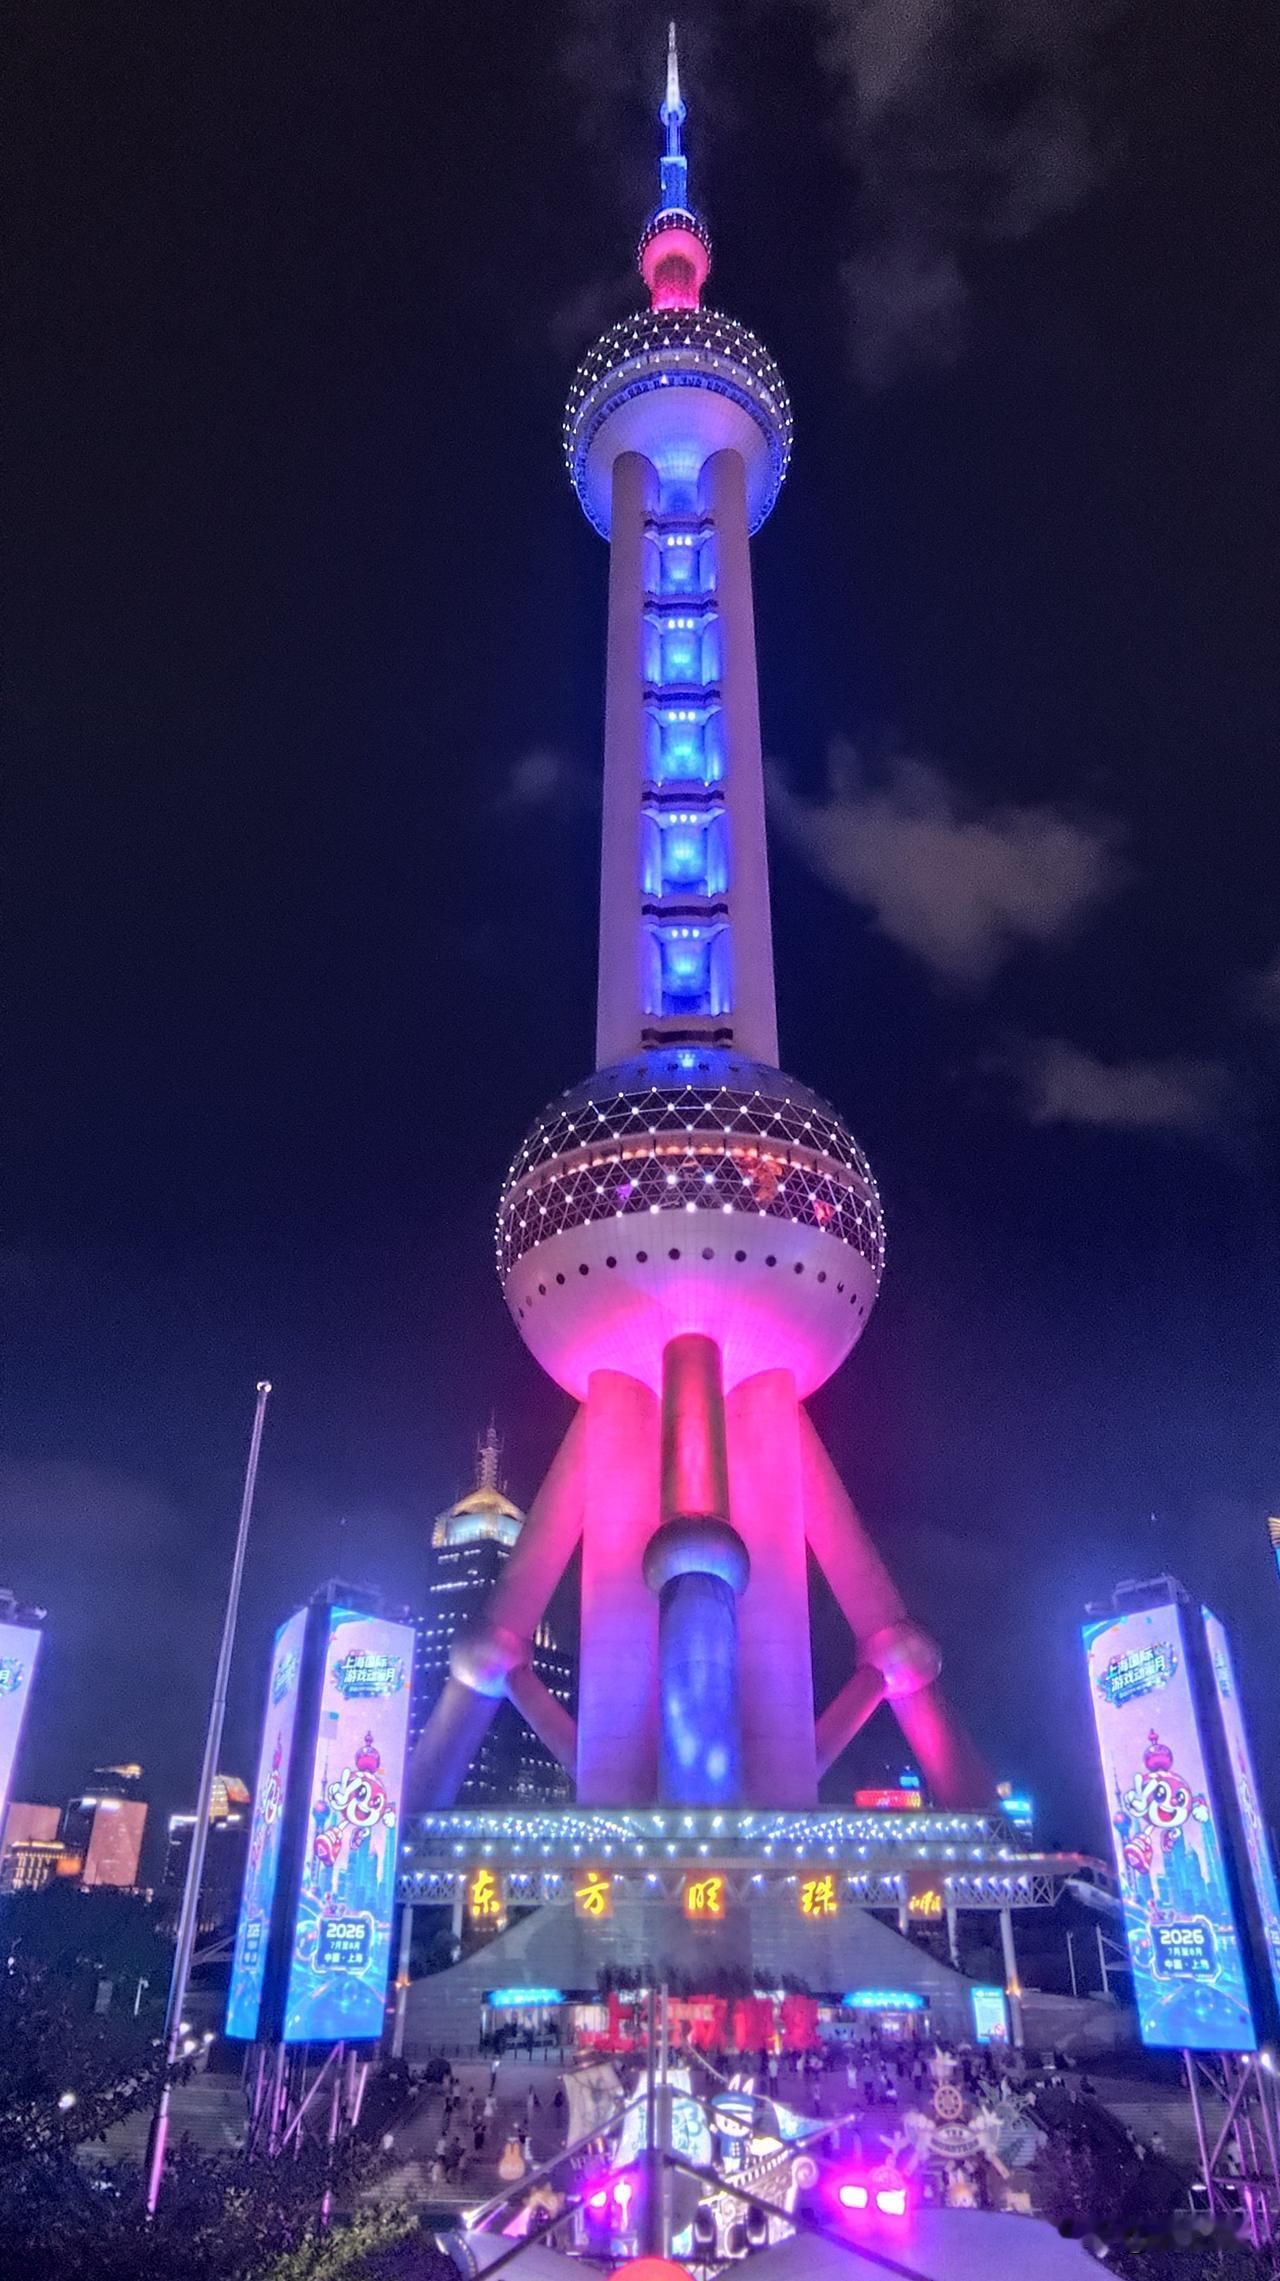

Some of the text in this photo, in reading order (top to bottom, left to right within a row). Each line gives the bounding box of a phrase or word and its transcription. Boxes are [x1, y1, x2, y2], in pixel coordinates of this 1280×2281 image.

[341, 1655, 389, 1669] 上海国际
[472, 1869, 837, 1916] 东方明珠
[326, 1922, 365, 1939] 2026
[1160, 1928, 1205, 1944] 2026
